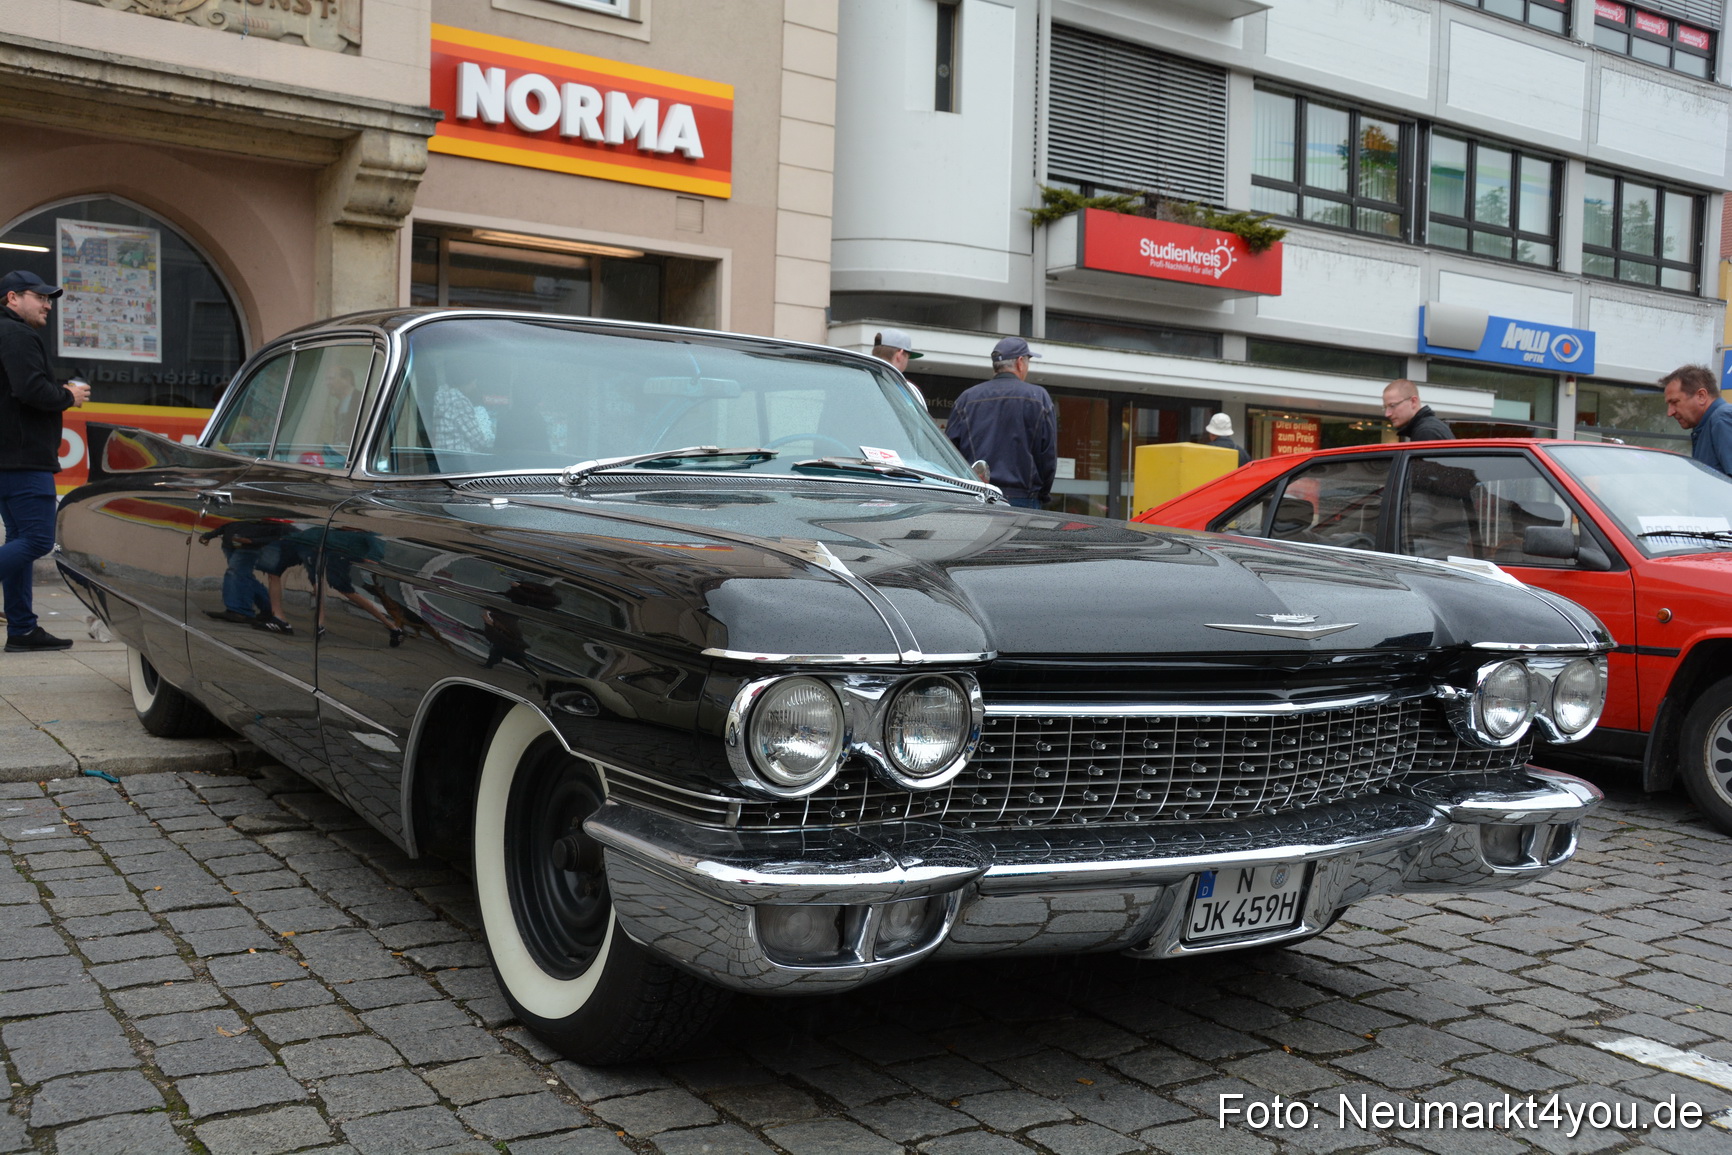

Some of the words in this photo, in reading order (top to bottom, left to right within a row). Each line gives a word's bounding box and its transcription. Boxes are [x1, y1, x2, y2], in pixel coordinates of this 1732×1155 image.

[456, 61, 704, 158] NORMA
[1140, 238, 1221, 267] Studienkreis
[1150, 259, 1192, 273] Profi-Nachhilfe
[1193, 265, 1201, 274] für
[1501, 322, 1550, 354] APOLLO
[1523, 353, 1545, 364] OPTIK
[1278, 433, 1295, 442] zum
[1296, 432, 1315, 443] Preis
[1278, 445, 1292, 454] von
[1201, 886, 1209, 896] D
[1237, 867, 1256, 894] N
[1193, 900, 1231, 933] JK
[1232, 891, 1297, 928] 459H
